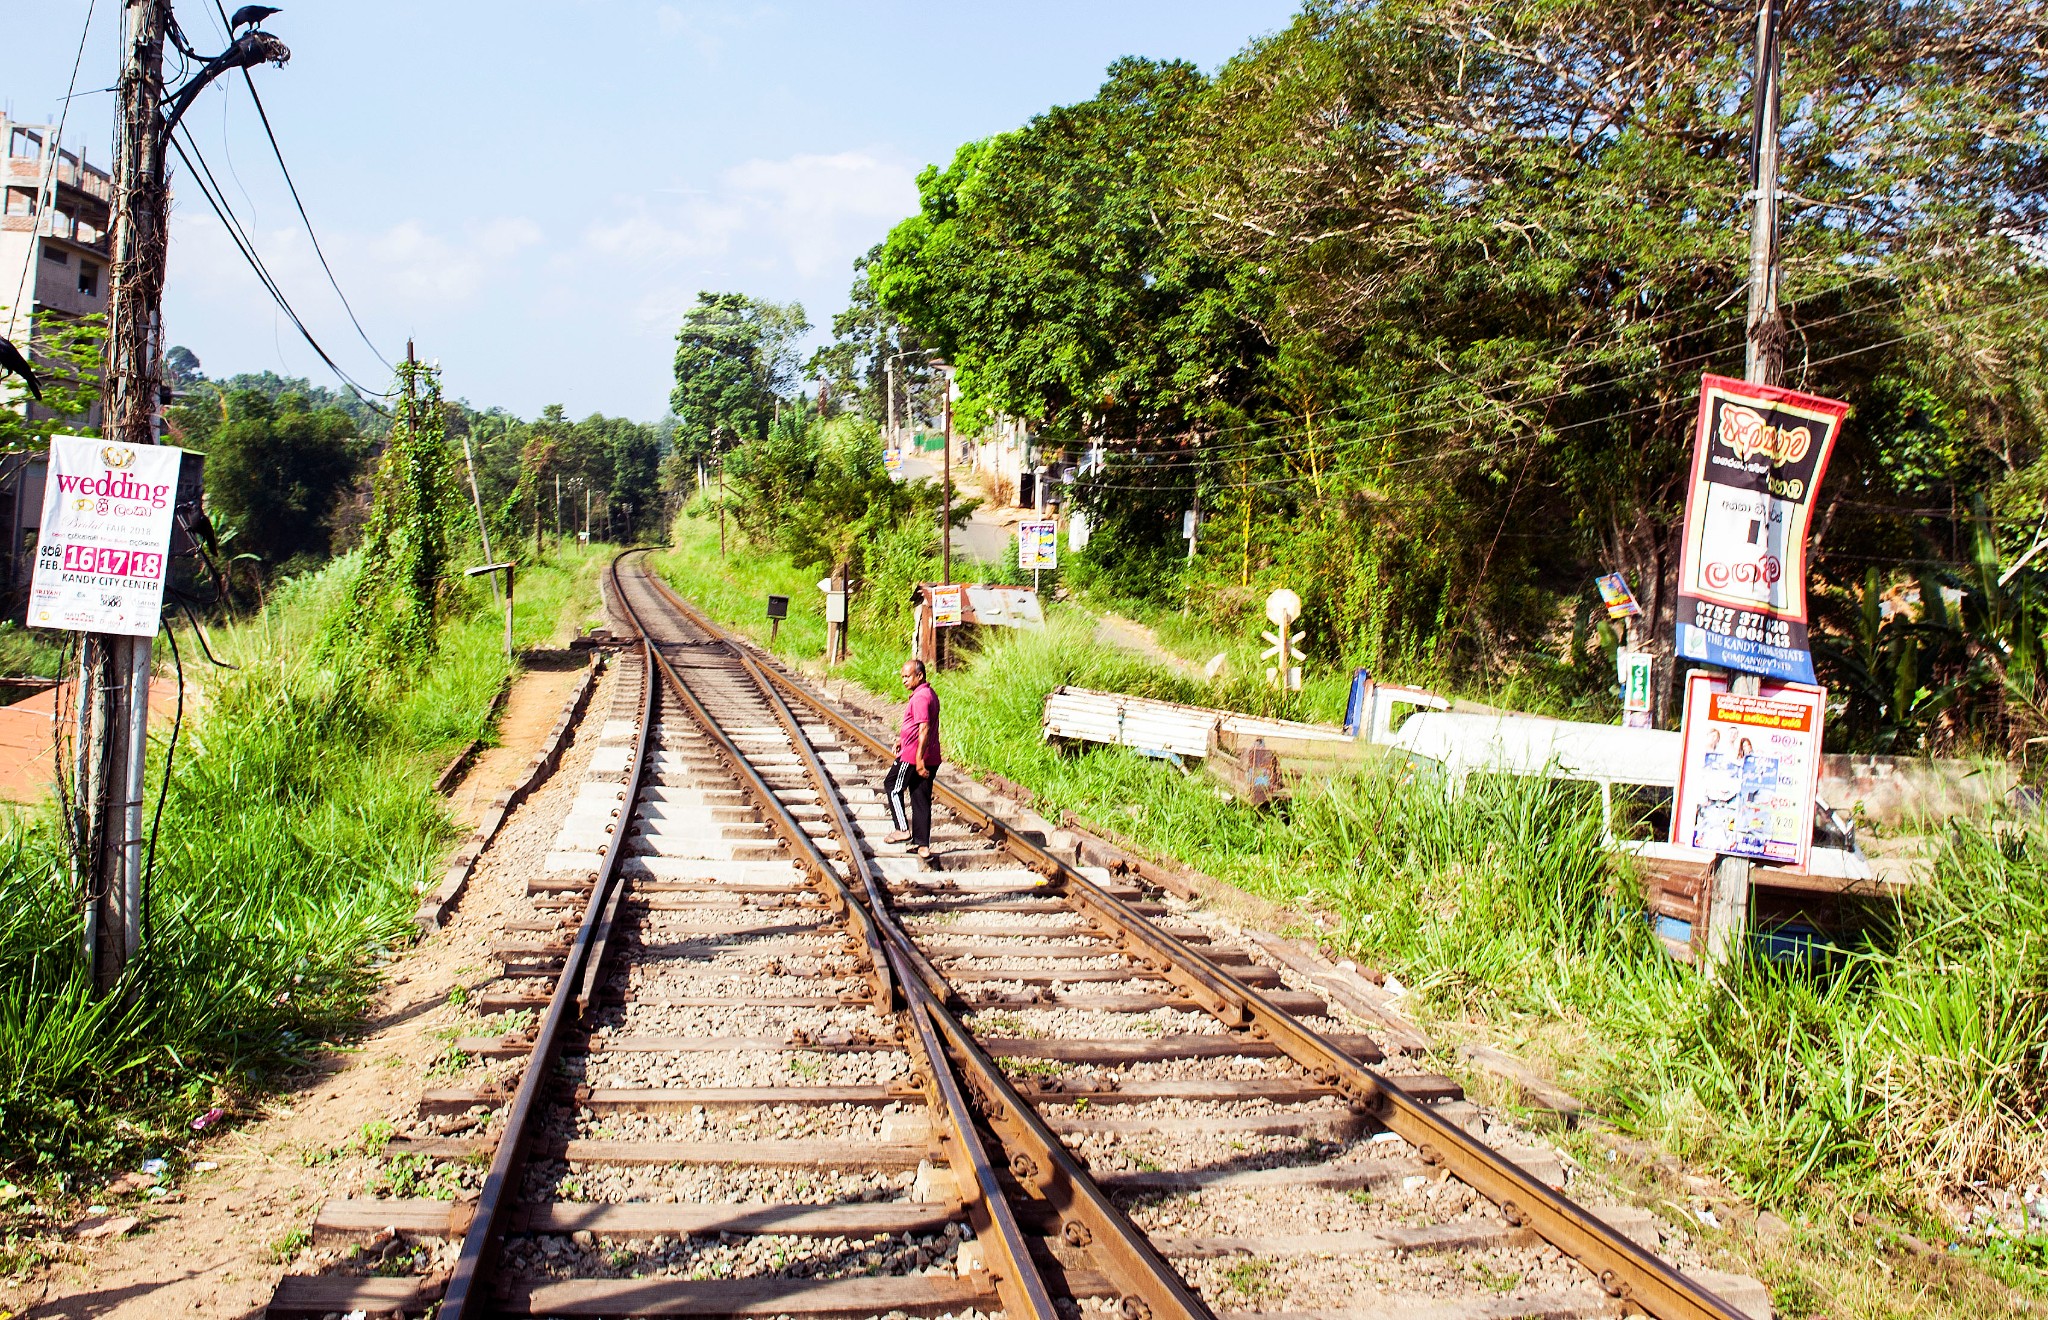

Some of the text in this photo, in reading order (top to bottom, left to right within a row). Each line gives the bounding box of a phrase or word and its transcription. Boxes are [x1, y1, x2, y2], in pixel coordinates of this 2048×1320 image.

[57, 471, 169, 509] wedding
[129, 525, 152, 536] 2018
[39, 560, 62, 571] FEB.
[66, 547, 161, 578] 16 17 18
[62, 573, 97, 586] KANDY
[99, 576, 121, 588] CITY
[122, 579, 159, 591] CENTER
[1696, 601, 1736, 623] 0757
[1695, 614, 1731, 636] 0755
[1706, 632, 1723, 647] THE
[1724, 635, 1758, 654] KANDY
